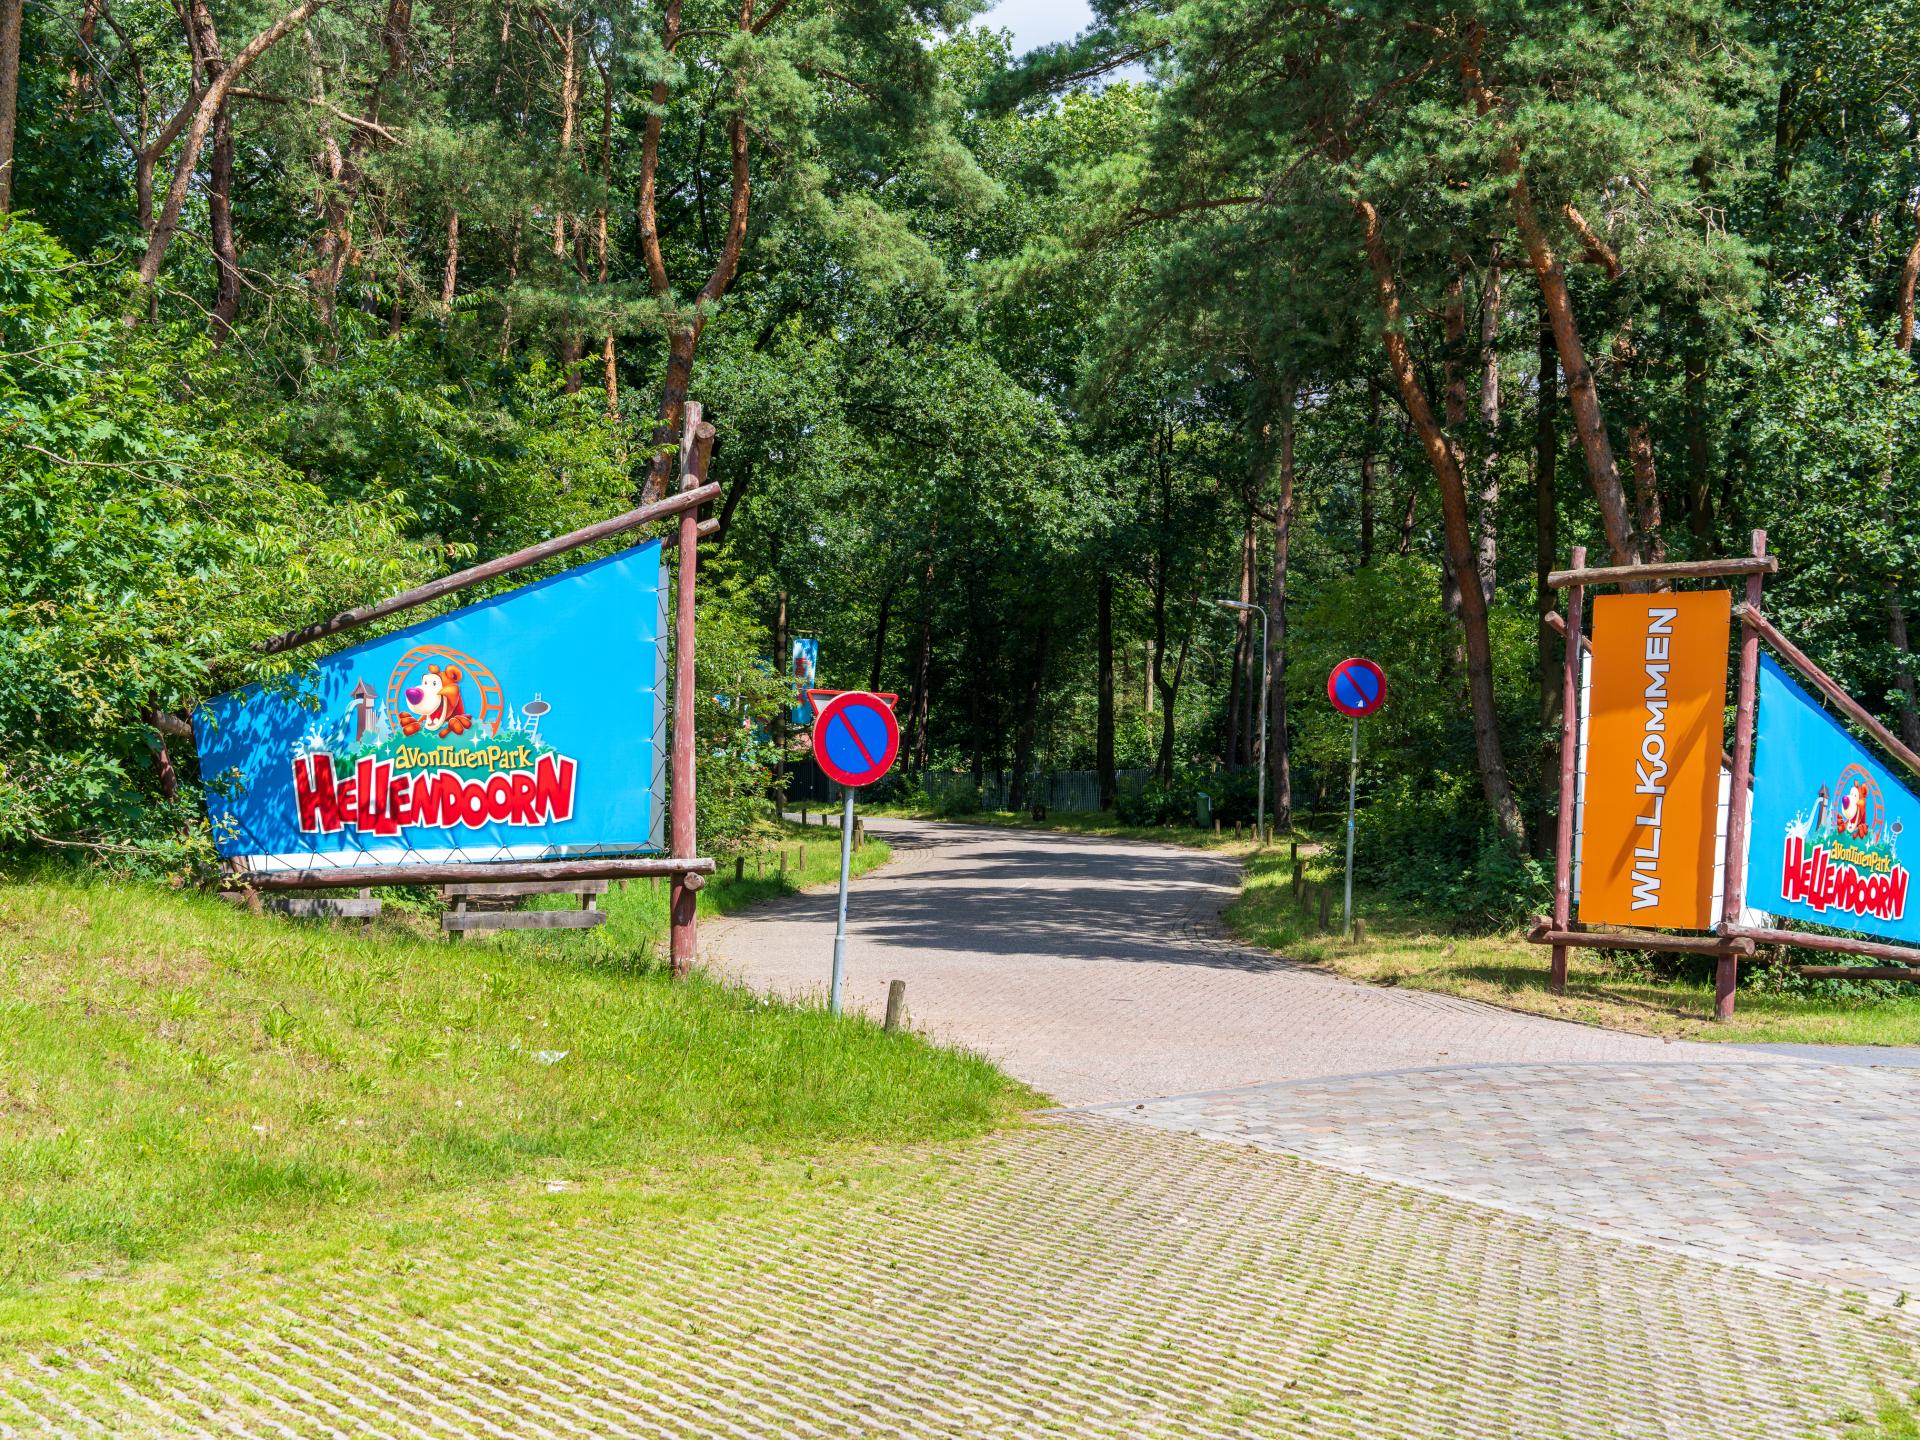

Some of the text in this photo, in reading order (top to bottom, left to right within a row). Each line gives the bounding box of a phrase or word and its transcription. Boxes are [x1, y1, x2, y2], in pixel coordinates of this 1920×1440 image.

[293, 754, 574, 835] HELLENDOORN
[1631, 608, 1678, 910] WILLKOMMEN
[1782, 836, 1907, 919] HELLENDOORN
